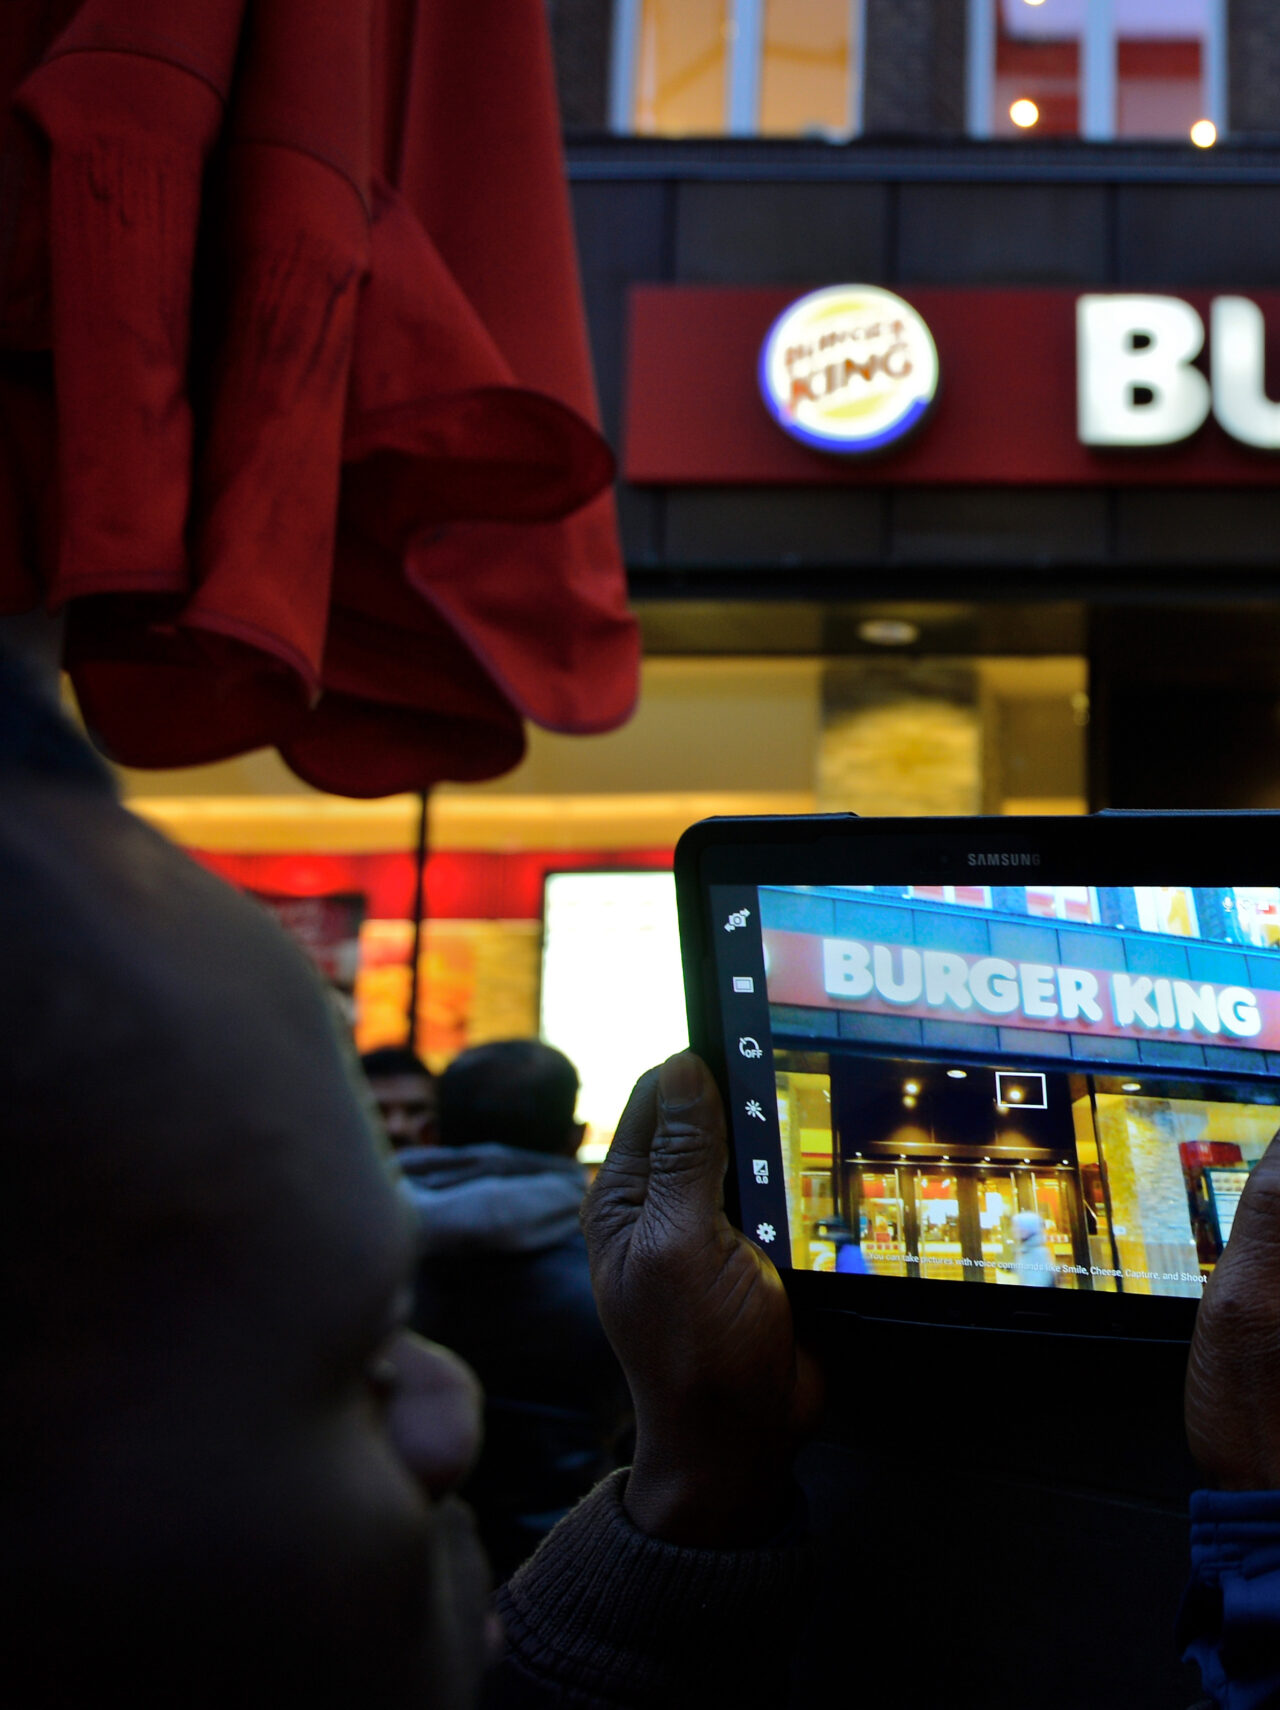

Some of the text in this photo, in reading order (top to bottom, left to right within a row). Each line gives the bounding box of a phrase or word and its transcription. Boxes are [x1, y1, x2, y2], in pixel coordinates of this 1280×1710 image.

[967, 853, 1041, 866] SAMSUNG
[822, 938, 1263, 1038] BURGER KING
[745, 1049, 763, 1059] OFF
[755, 1175, 769, 1184] 0.0
[869, 1252, 885, 1261] You
[902, 1252, 919, 1263] take
[920, 1254, 953, 1266] pictures
[955, 1257, 973, 1267] with
[974, 1259, 996, 1268] voice
[1062, 1264, 1089, 1276] Smile,
[1090, 1266, 1124, 1278] Cheese,
[1125, 1269, 1161, 1281] Capture,
[1162, 1272, 1179, 1281] and
[1180, 1274, 1208, 1284] Shoot
